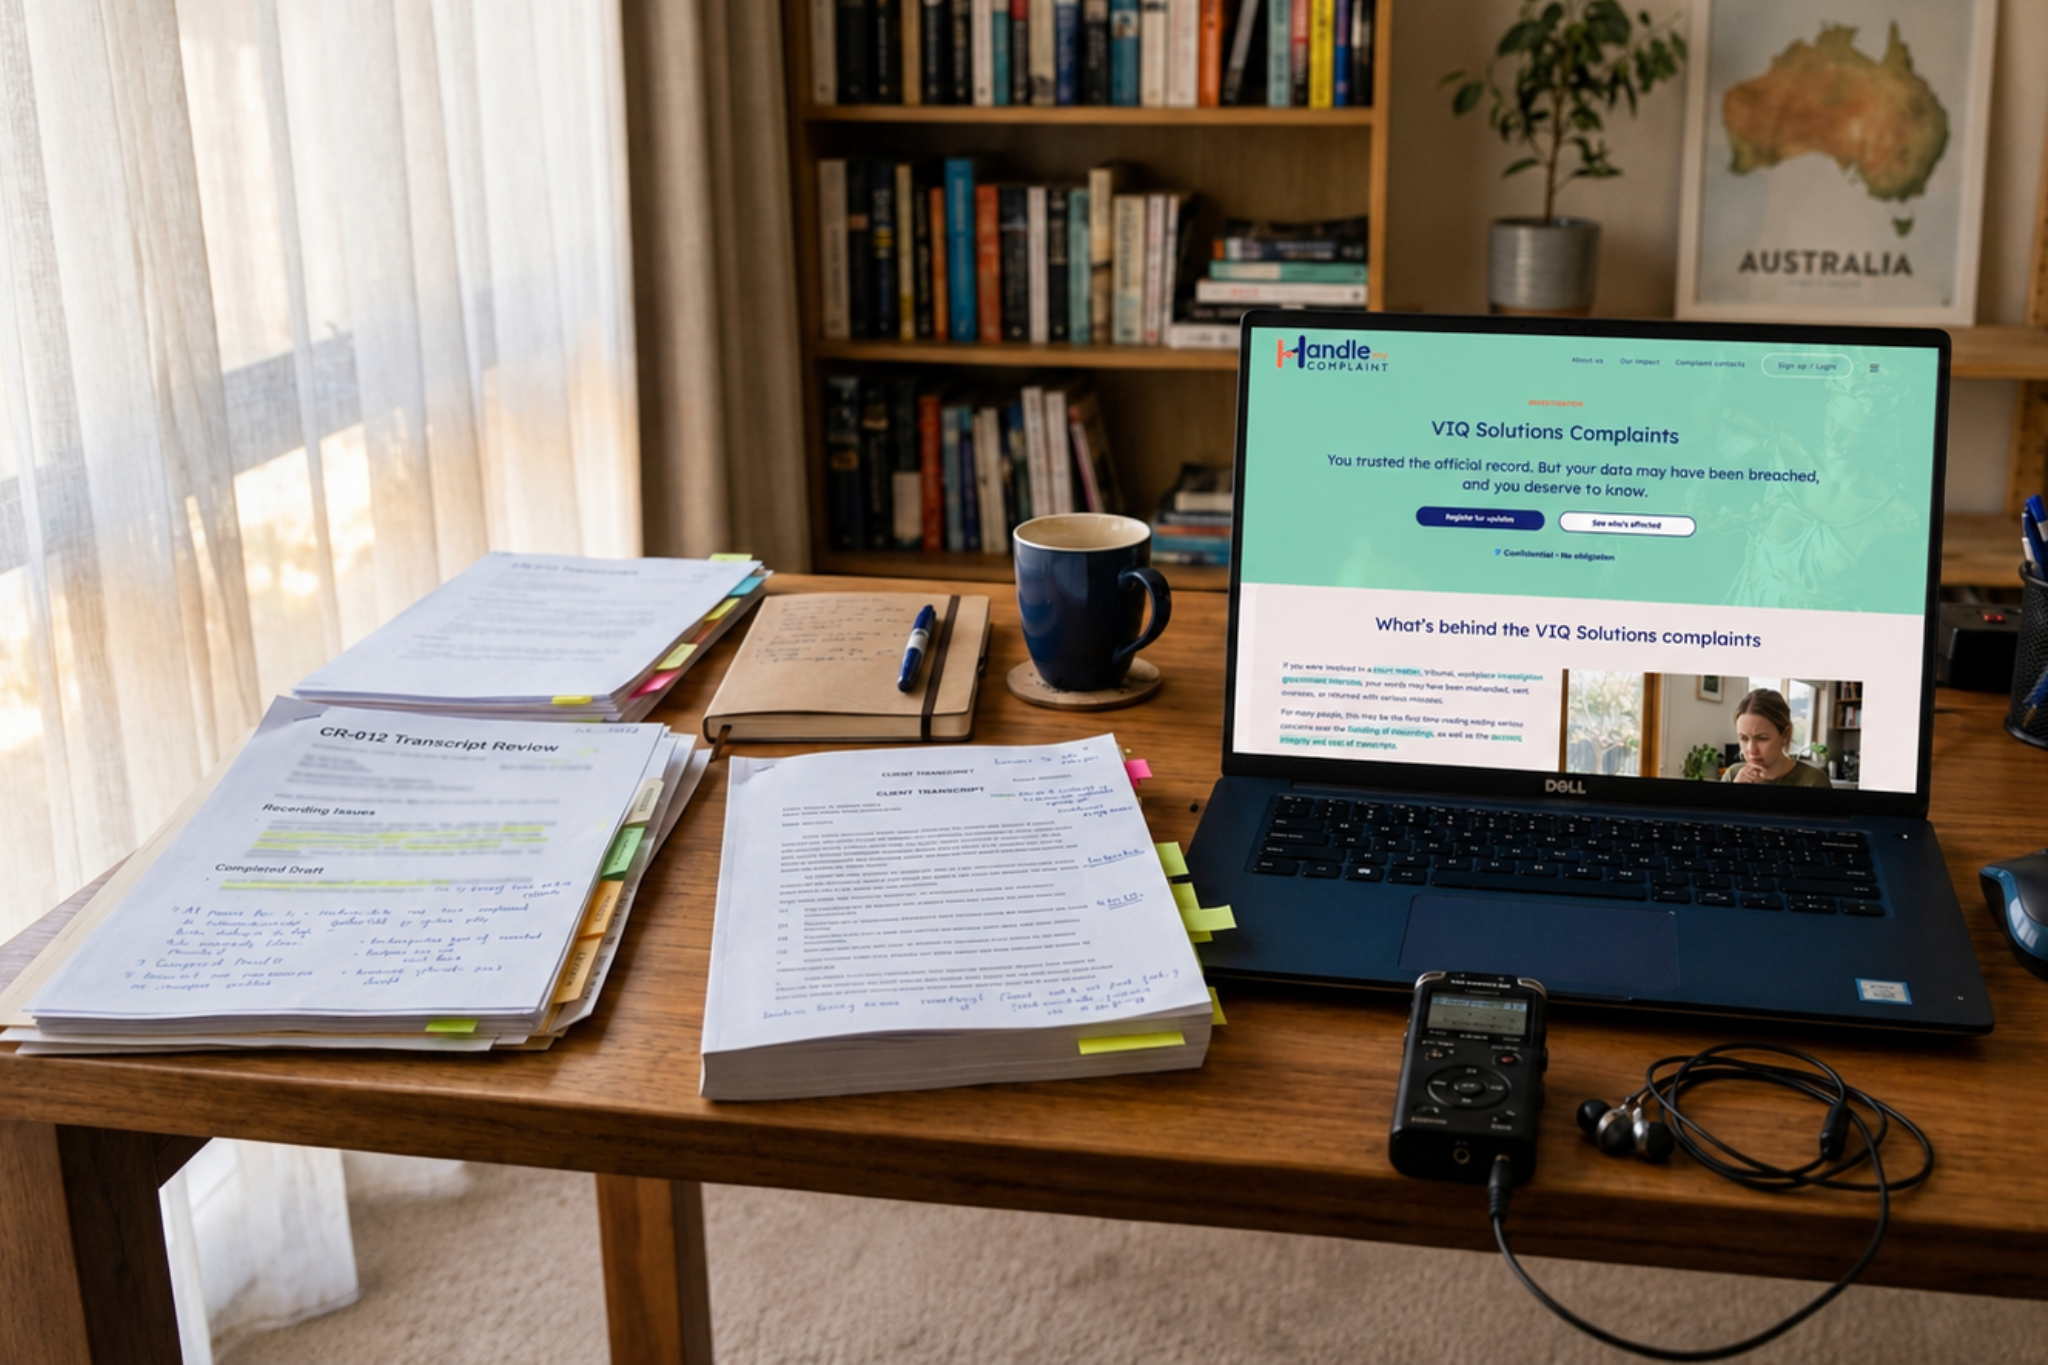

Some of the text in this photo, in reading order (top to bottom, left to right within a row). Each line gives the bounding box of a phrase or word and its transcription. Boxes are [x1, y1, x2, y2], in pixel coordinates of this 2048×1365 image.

[1738, 249, 1914, 277] AUSTRALIA
[1276, 335, 1371, 369] Handle
[1306, 361, 1388, 372] COMPLAINT
[1431, 420, 1679, 447] VIQ Solutions Complaints
[1327, 454, 1820, 485] You trusted the official record. But your data may have been breached,
[1462, 478, 1649, 498] and you deserve to know.
[1375, 616, 1761, 648] What's behind the VIQ Solutions complaints
[319, 726, 559, 753] CR-012 Transcript Review
[876, 789, 913, 797] CLIENT
[1545, 779, 1587, 794] DELL
[214, 862, 324, 875] Completed Draft
